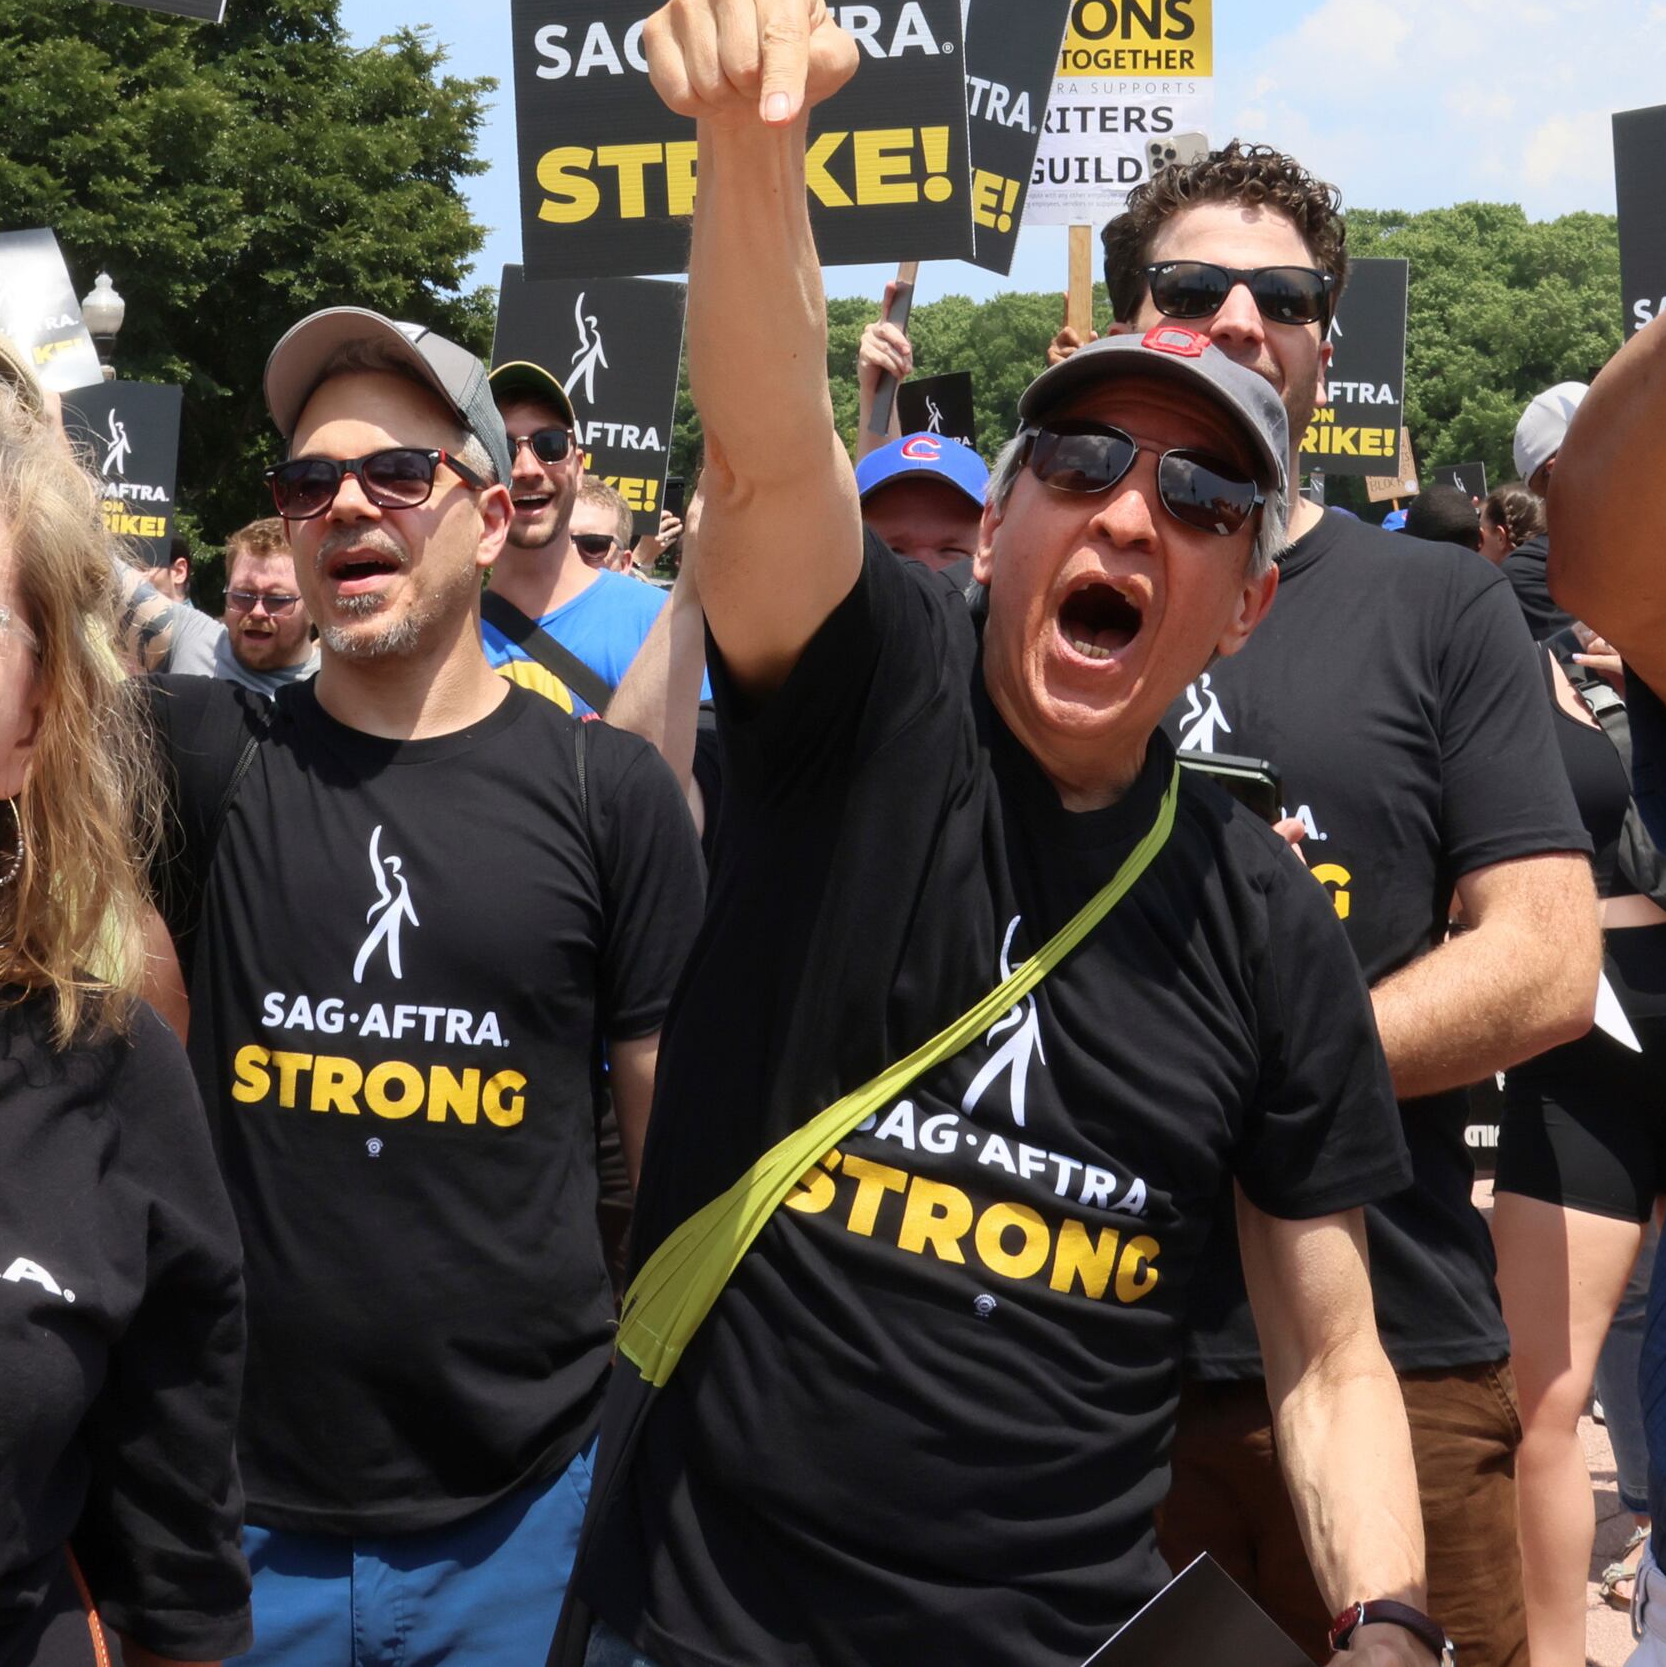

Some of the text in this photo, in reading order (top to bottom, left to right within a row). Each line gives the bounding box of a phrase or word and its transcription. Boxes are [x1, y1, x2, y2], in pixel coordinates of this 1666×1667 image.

[1061, 48, 1195, 70] TOGETHER
[1091, 82, 1196, 95] SUPPORTS
[231, 1045, 527, 1127] STRONG
[783, 1149, 1158, 1303] STRONG
